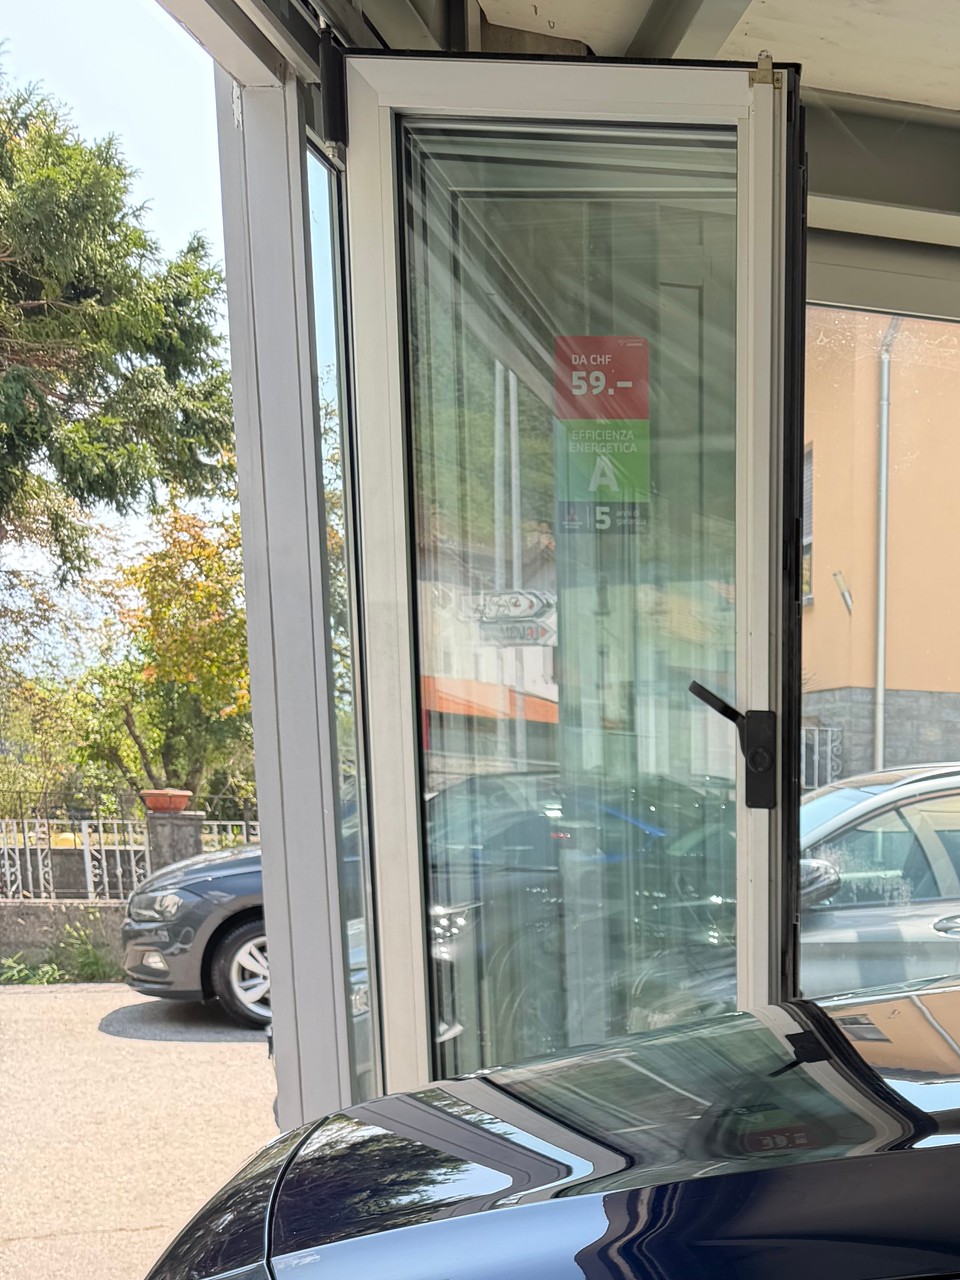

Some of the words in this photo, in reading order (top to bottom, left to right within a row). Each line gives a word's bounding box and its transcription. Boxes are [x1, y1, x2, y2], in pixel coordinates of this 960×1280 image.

[571, 354, 588, 365] DA
[589, 354, 612, 365] CHF
[572, 430, 635, 440] EFFICIENZA
[569, 442, 638, 453] ENERGETICA
[588, 455, 620, 492] A
[595, 506, 612, 530] 5
